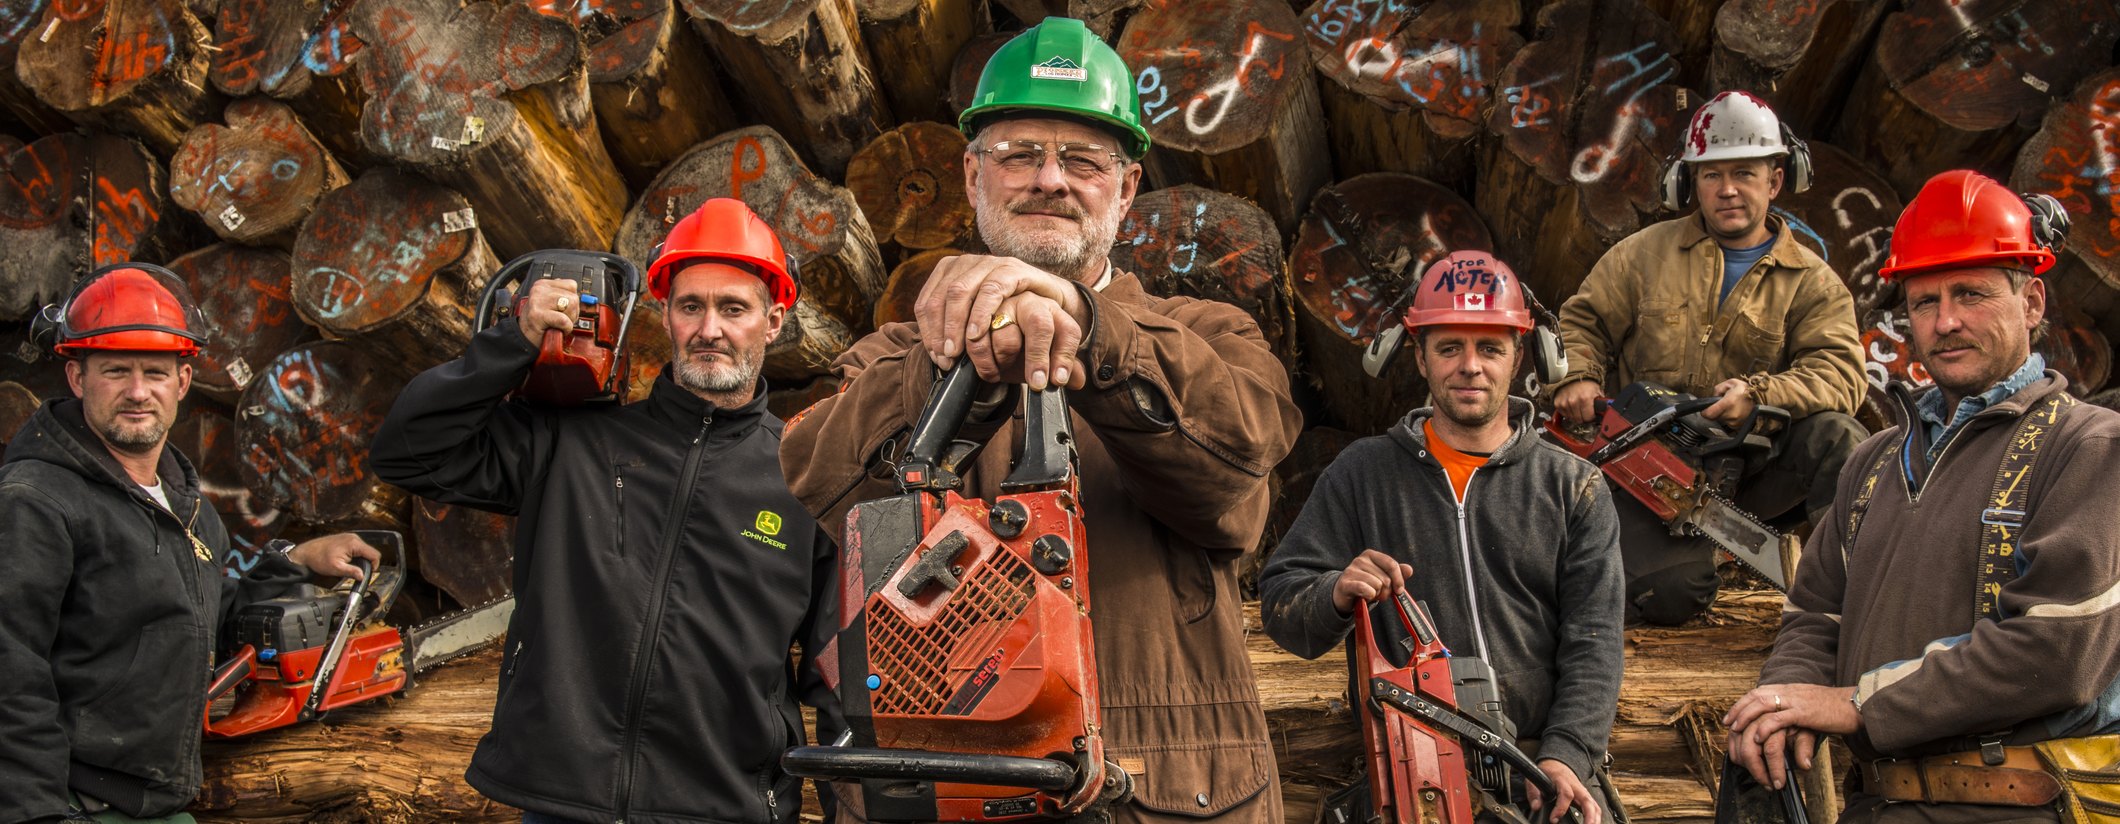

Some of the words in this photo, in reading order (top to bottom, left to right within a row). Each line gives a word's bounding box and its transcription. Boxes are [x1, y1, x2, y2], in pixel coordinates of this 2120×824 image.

[740, 529, 762, 541] JOHN
[762, 535, 787, 550] DEERE
[1987, 544, 1996, 555] 12
[1985, 563, 1994, 574] 13
[1983, 582, 1992, 594] 14
[1982, 602, 1990, 613] 15
